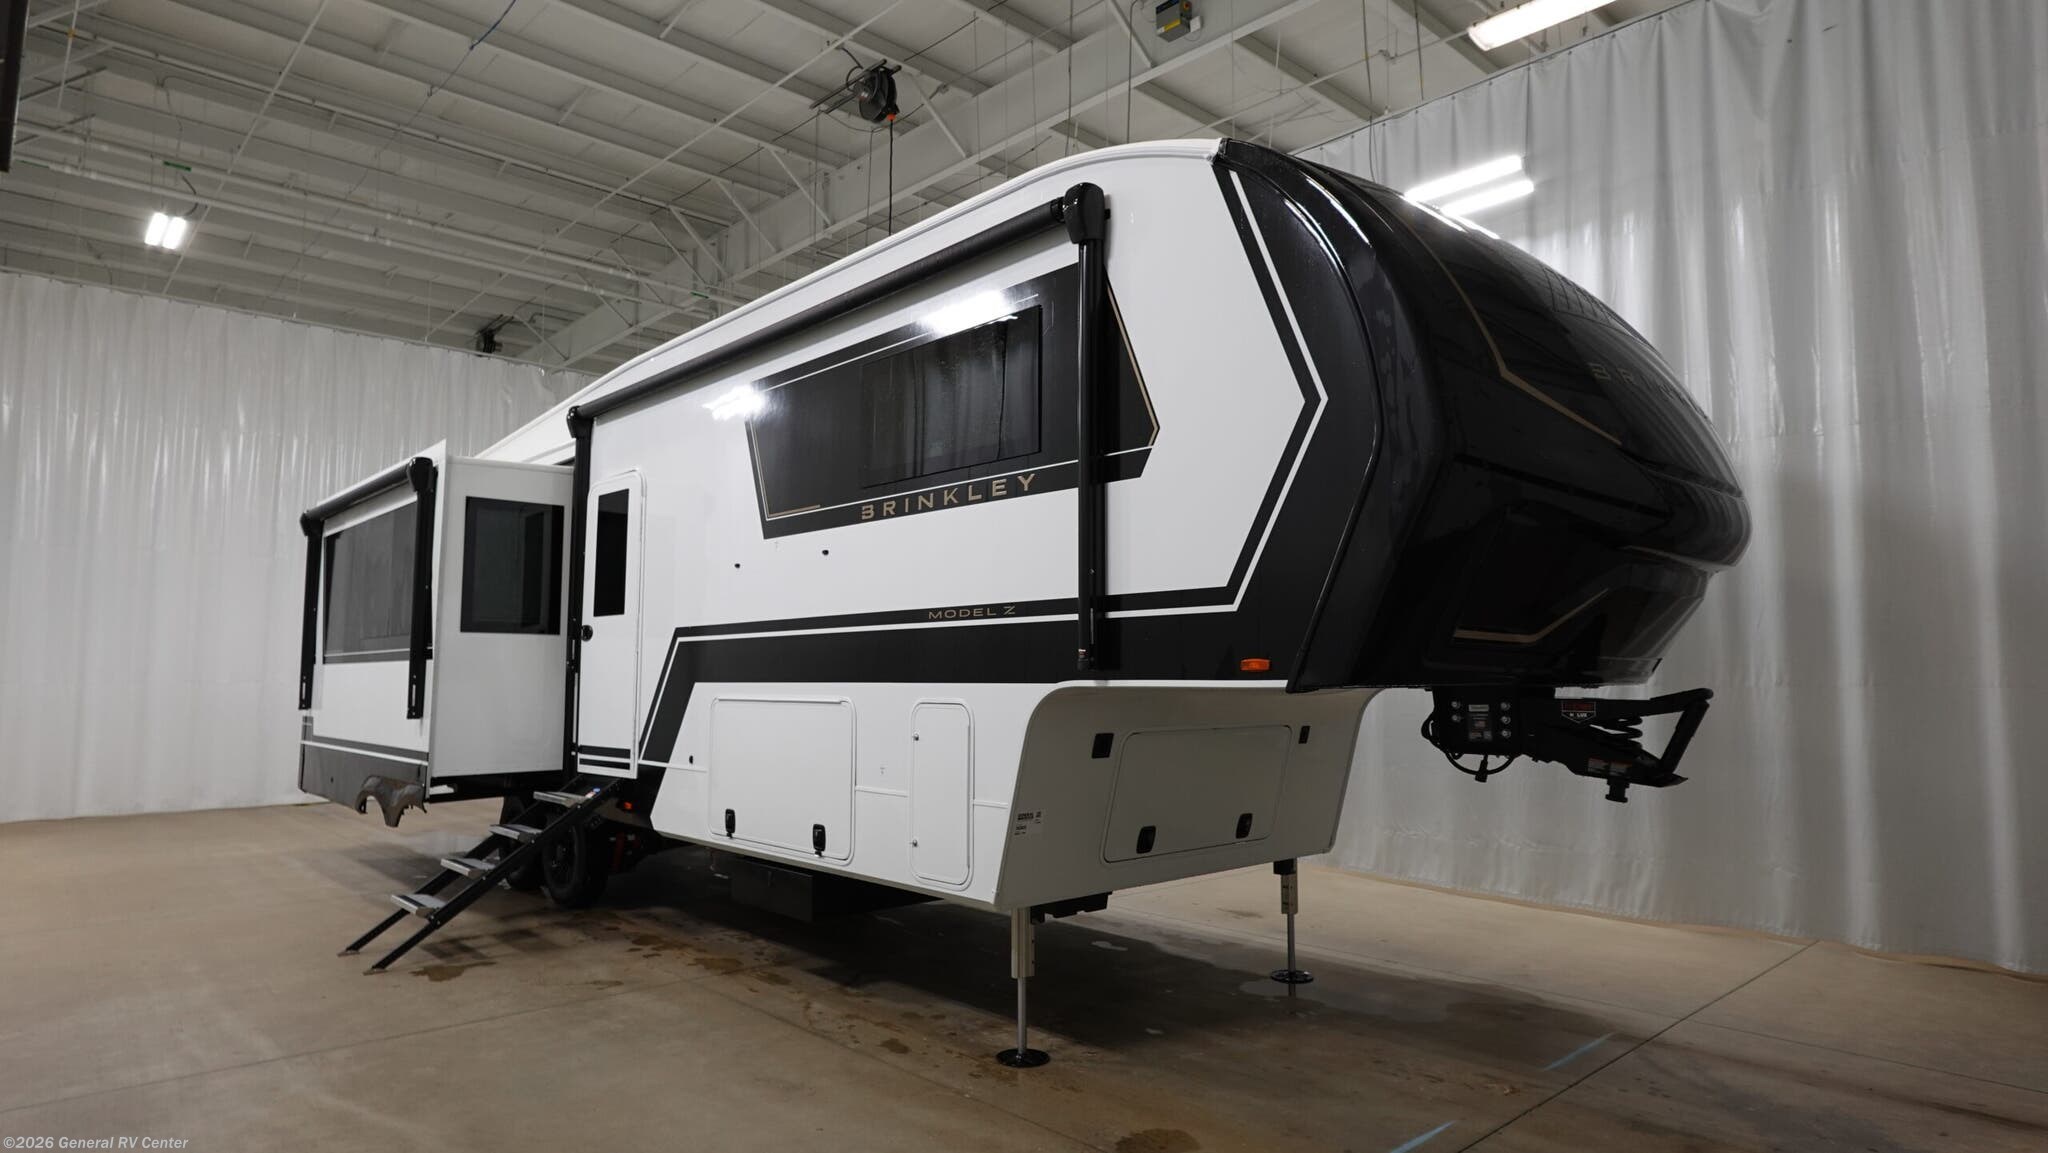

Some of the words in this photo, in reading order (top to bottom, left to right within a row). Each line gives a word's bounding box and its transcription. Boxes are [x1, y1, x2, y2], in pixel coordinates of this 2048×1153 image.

[861, 473, 1036, 520] BRINKLEY
[928, 607, 997, 620] MODEL
[1003, 605, 1016, 616] Z
